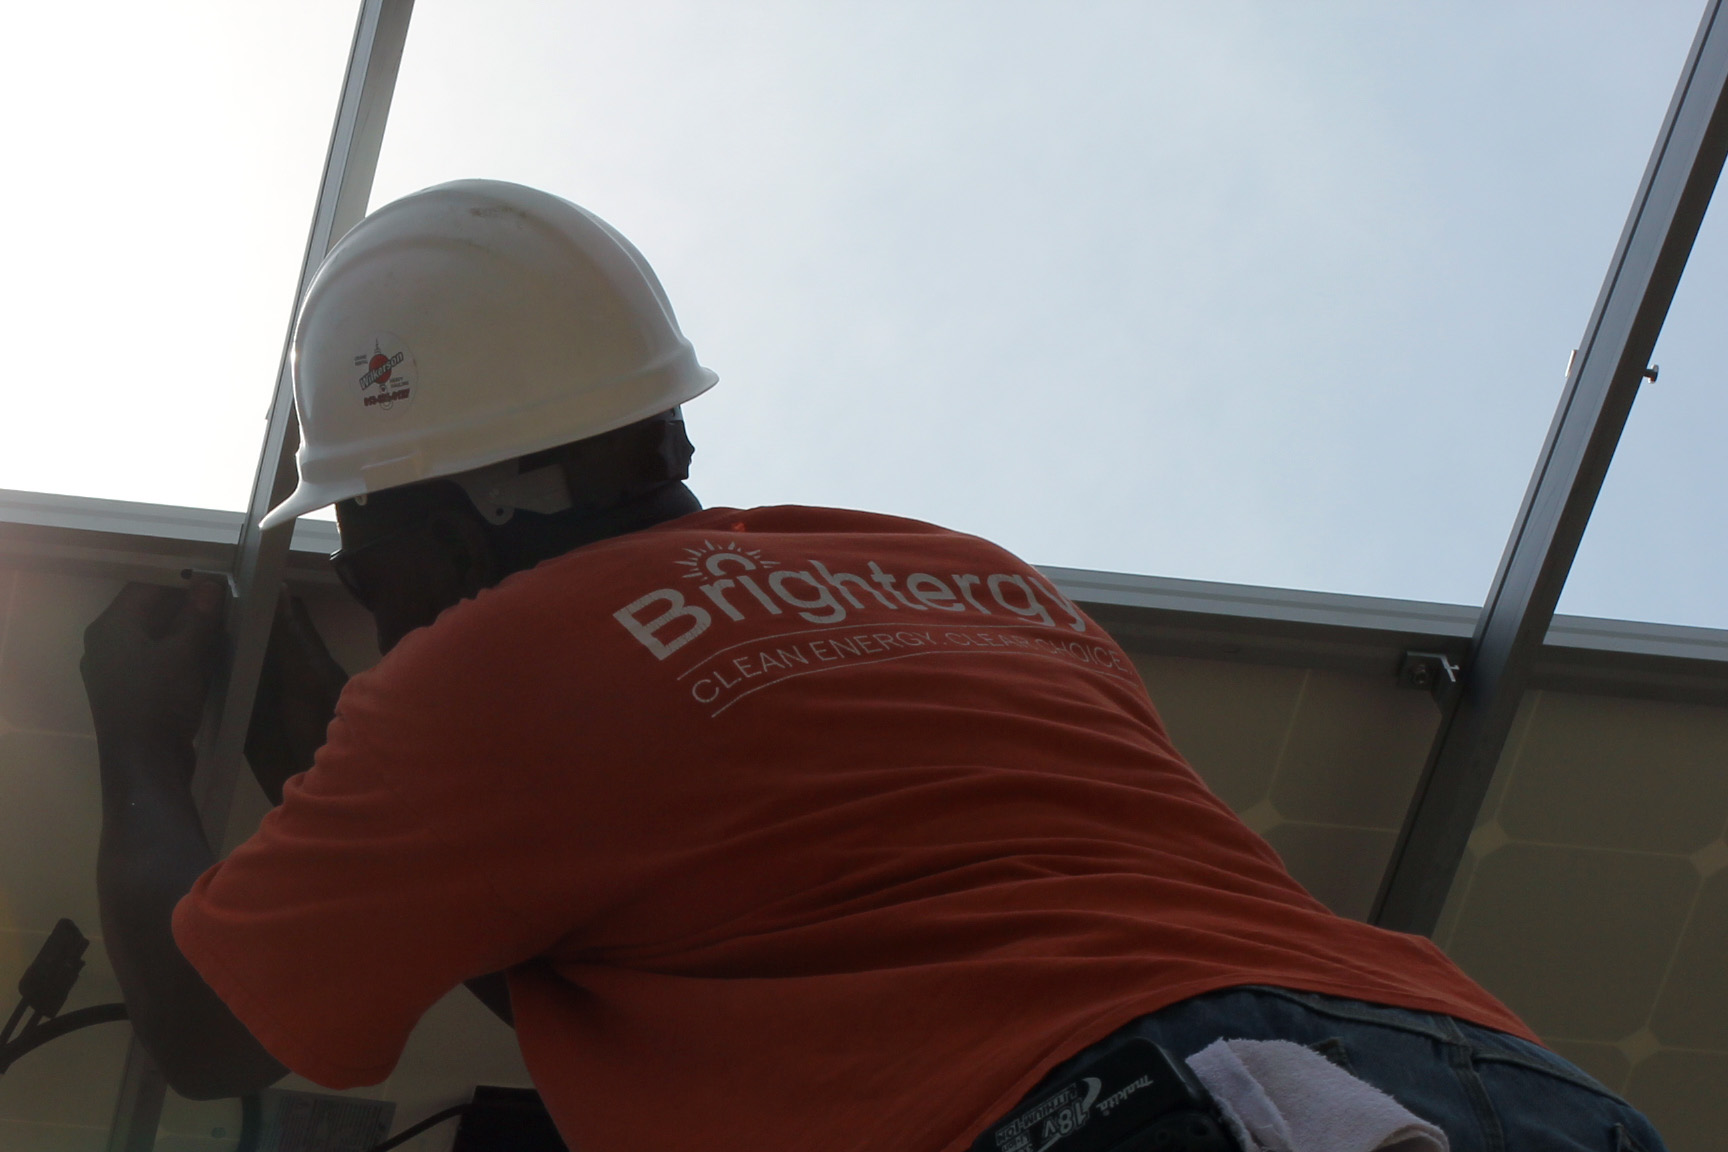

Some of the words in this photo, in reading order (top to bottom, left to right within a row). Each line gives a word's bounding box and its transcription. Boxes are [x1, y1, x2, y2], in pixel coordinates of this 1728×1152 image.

[612, 552, 1087, 661] Brightergy
[691, 645, 810, 703] CLEAN
[995, 1081, 1080, 1147] LITHIUM-ION
[1096, 1074, 1154, 1112] makita
